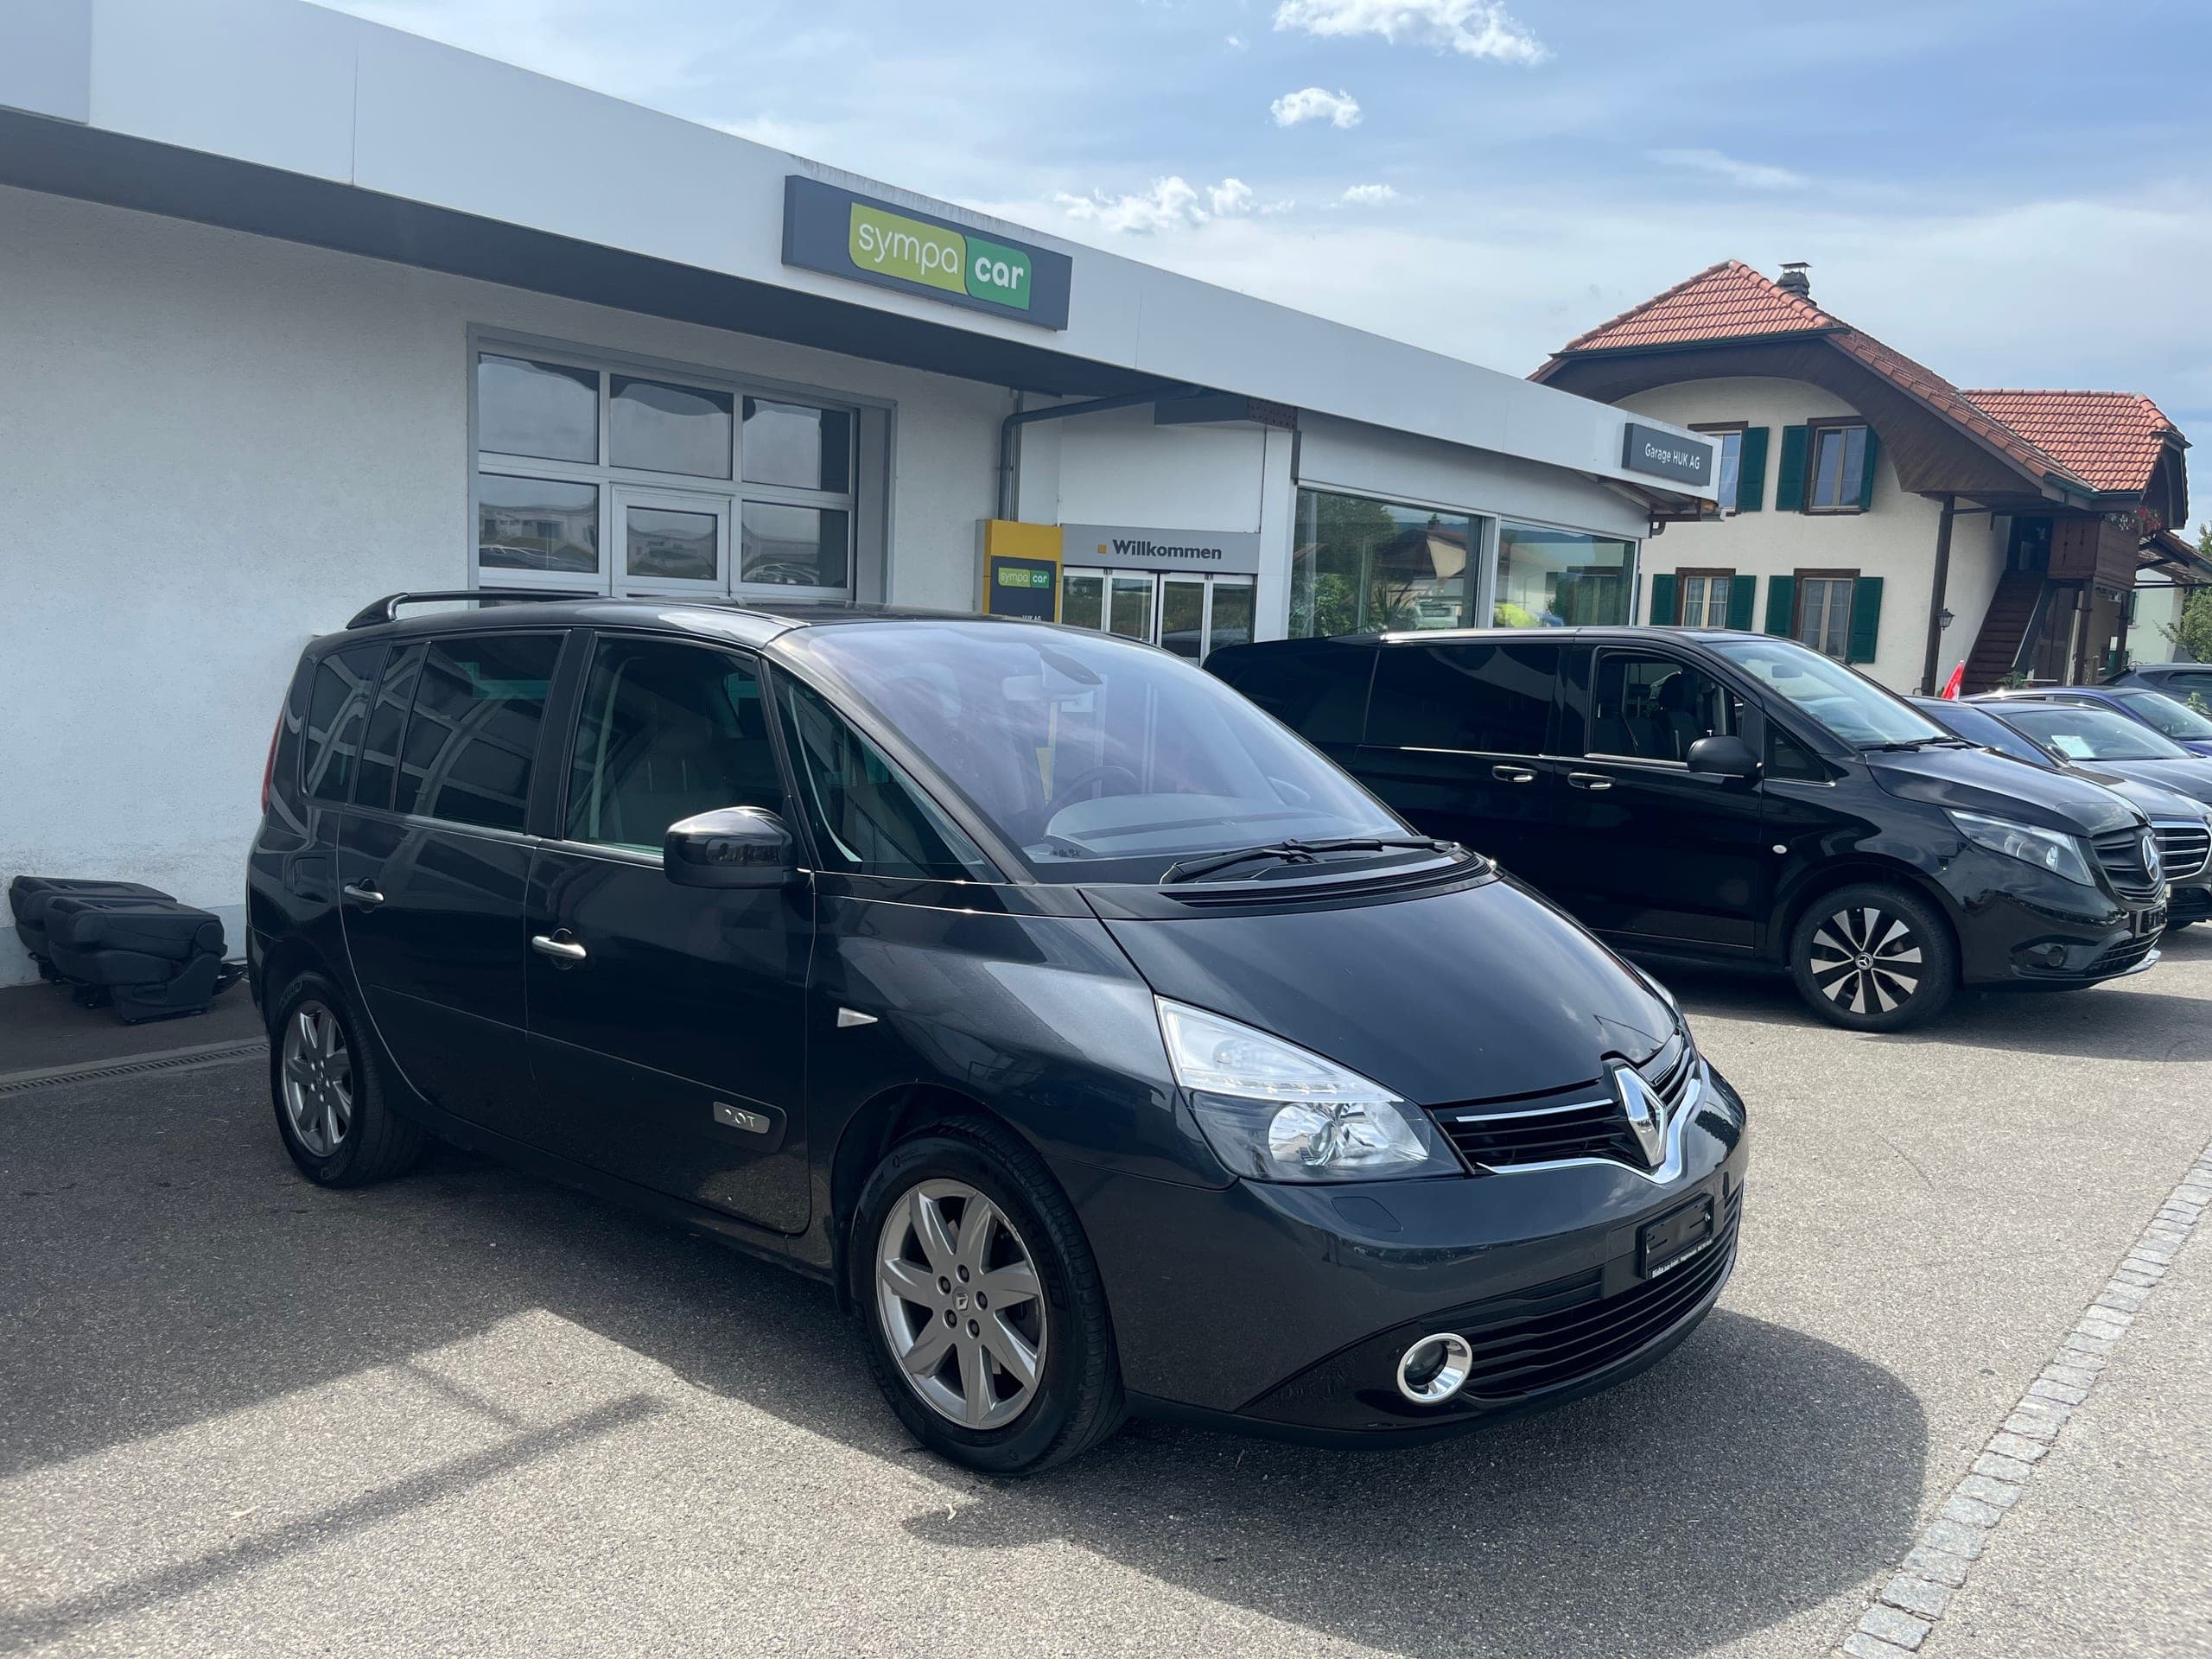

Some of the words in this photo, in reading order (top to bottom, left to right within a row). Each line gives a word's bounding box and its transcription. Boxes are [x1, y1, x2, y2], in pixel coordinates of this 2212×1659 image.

[858, 223, 958, 276] sympa
[975, 257, 1024, 289] car
[1645, 442, 1671, 463] Garage
[1673, 450, 1688, 467] HUK
[1688, 456, 1700, 469] AG
[1112, 539, 1222, 560] Willkommen
[1001, 572, 1028, 584] sympa
[1033, 575, 1047, 583] car
